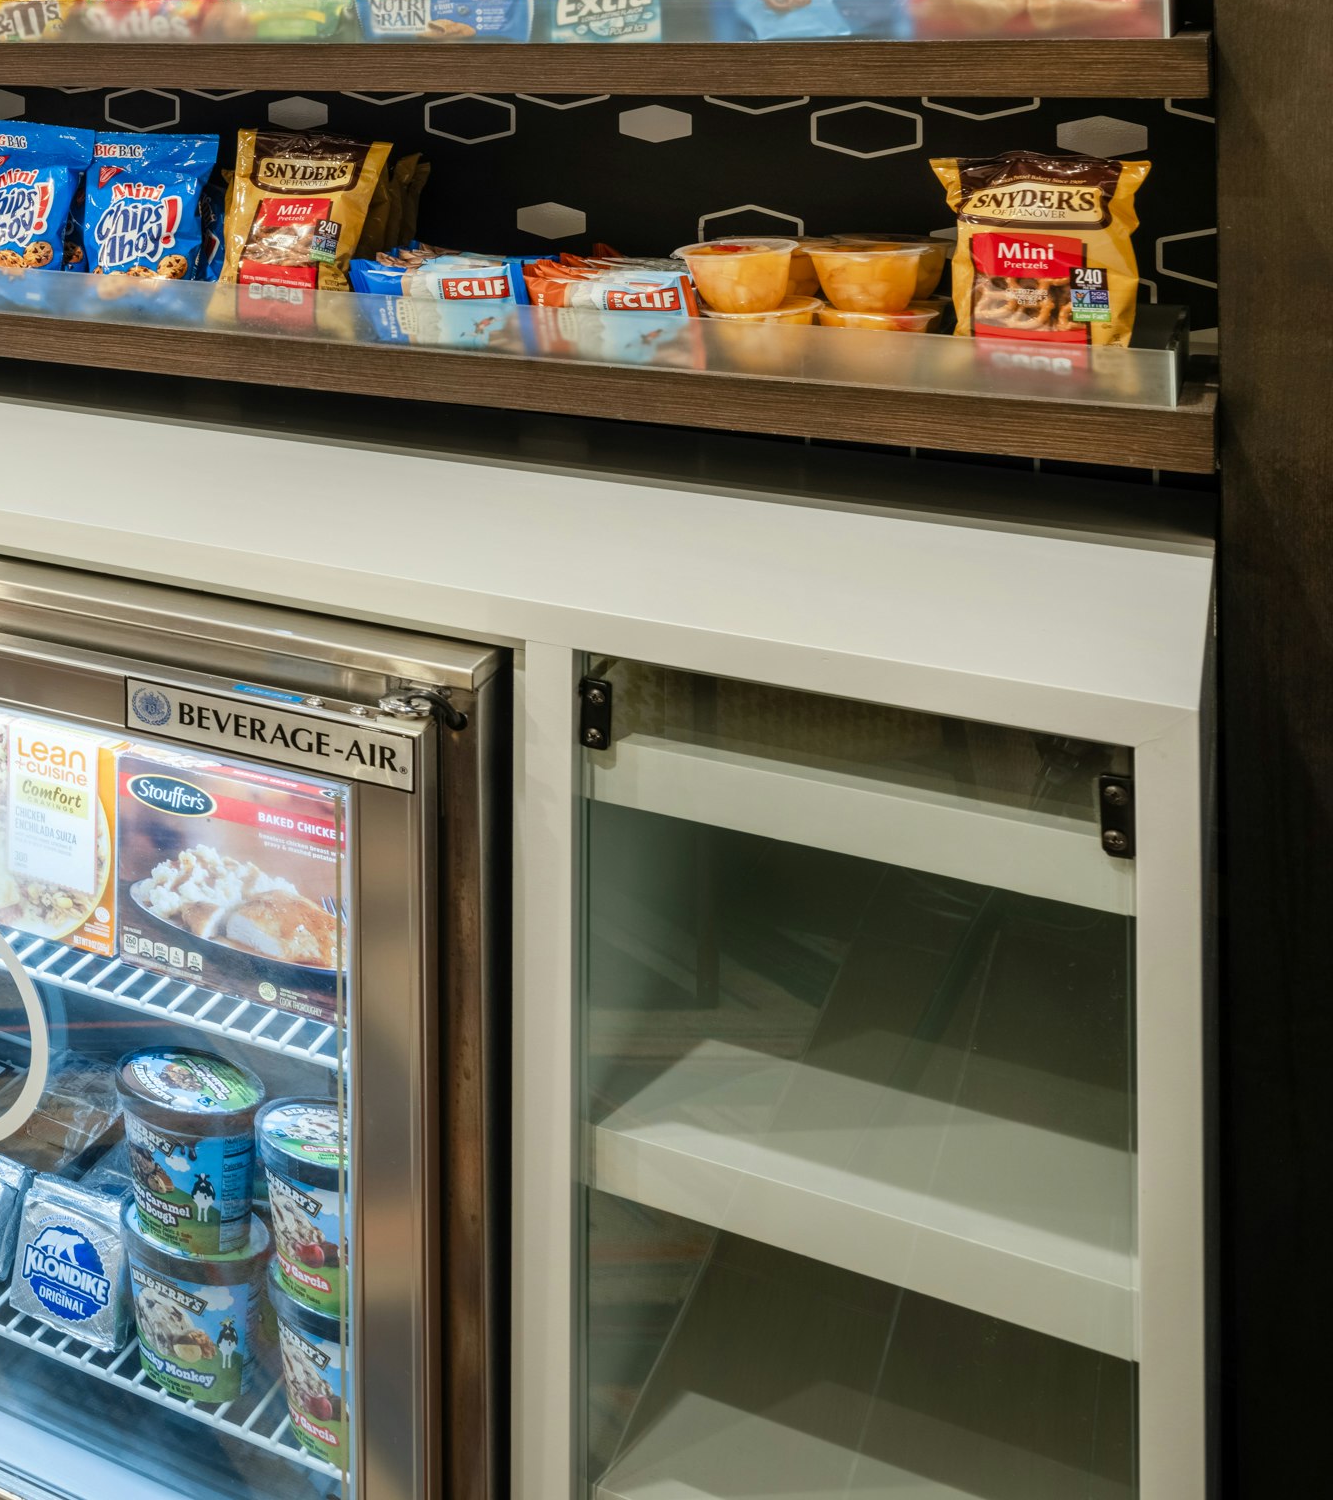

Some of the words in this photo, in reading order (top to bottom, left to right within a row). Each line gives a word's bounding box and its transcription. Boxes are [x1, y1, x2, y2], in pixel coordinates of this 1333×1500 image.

[608, 26, 632, 36] POLAR
[7, 136, 27, 149] BAG
[95, 143, 117, 157] BIG
[118, 145, 141, 158] BAG
[263, 161, 348, 181] SNYDER'S
[1031, 175, 1051, 183] Bakery
[111, 182, 165, 202] Mini
[291, 179, 329, 187] HANOVER
[277, 203, 314, 216] Mini
[973, 189, 1096, 213] SNYDER'S
[96, 201, 163, 239] Chips
[992, 208, 1007, 216] OF
[1008, 208, 1067, 220] HANOVER
[319, 220, 338, 235] 240
[997, 242, 1054, 260] Mini
[1004, 260, 1049, 270] Pretzels
[1075, 268, 1102, 285] 240
[446, 280, 455, 298] BAR
[456, 278, 506, 297] CLIF
[613, 293, 622, 309] BAR
[622, 291, 676, 311] CLIF
[178, 700, 398, 774] BEVERAGE-AIR
[17, 737, 86, 772] Lean
[22, 779, 82, 808] Comfort
[138, 778, 206, 811] Stouffer's
[15, 806, 46, 823] CHICKEN
[27, 796, 74, 814] CRAVINGS
[258, 811, 294, 829] BAKED
[15, 817, 54, 838] ENCHILADA
[55, 830, 77, 845] SUIZA
[146, 1190, 191, 1217] Caramel
[146, 1204, 177, 1226] Dough
[23, 1244, 111, 1306] KLONDIKE
[292, 1263, 330, 1291] Garcia
[38, 1285, 86, 1316] ORIGINAL
[166, 1360, 215, 1387] Monkey
[300, 1414, 337, 1446] Garcia
